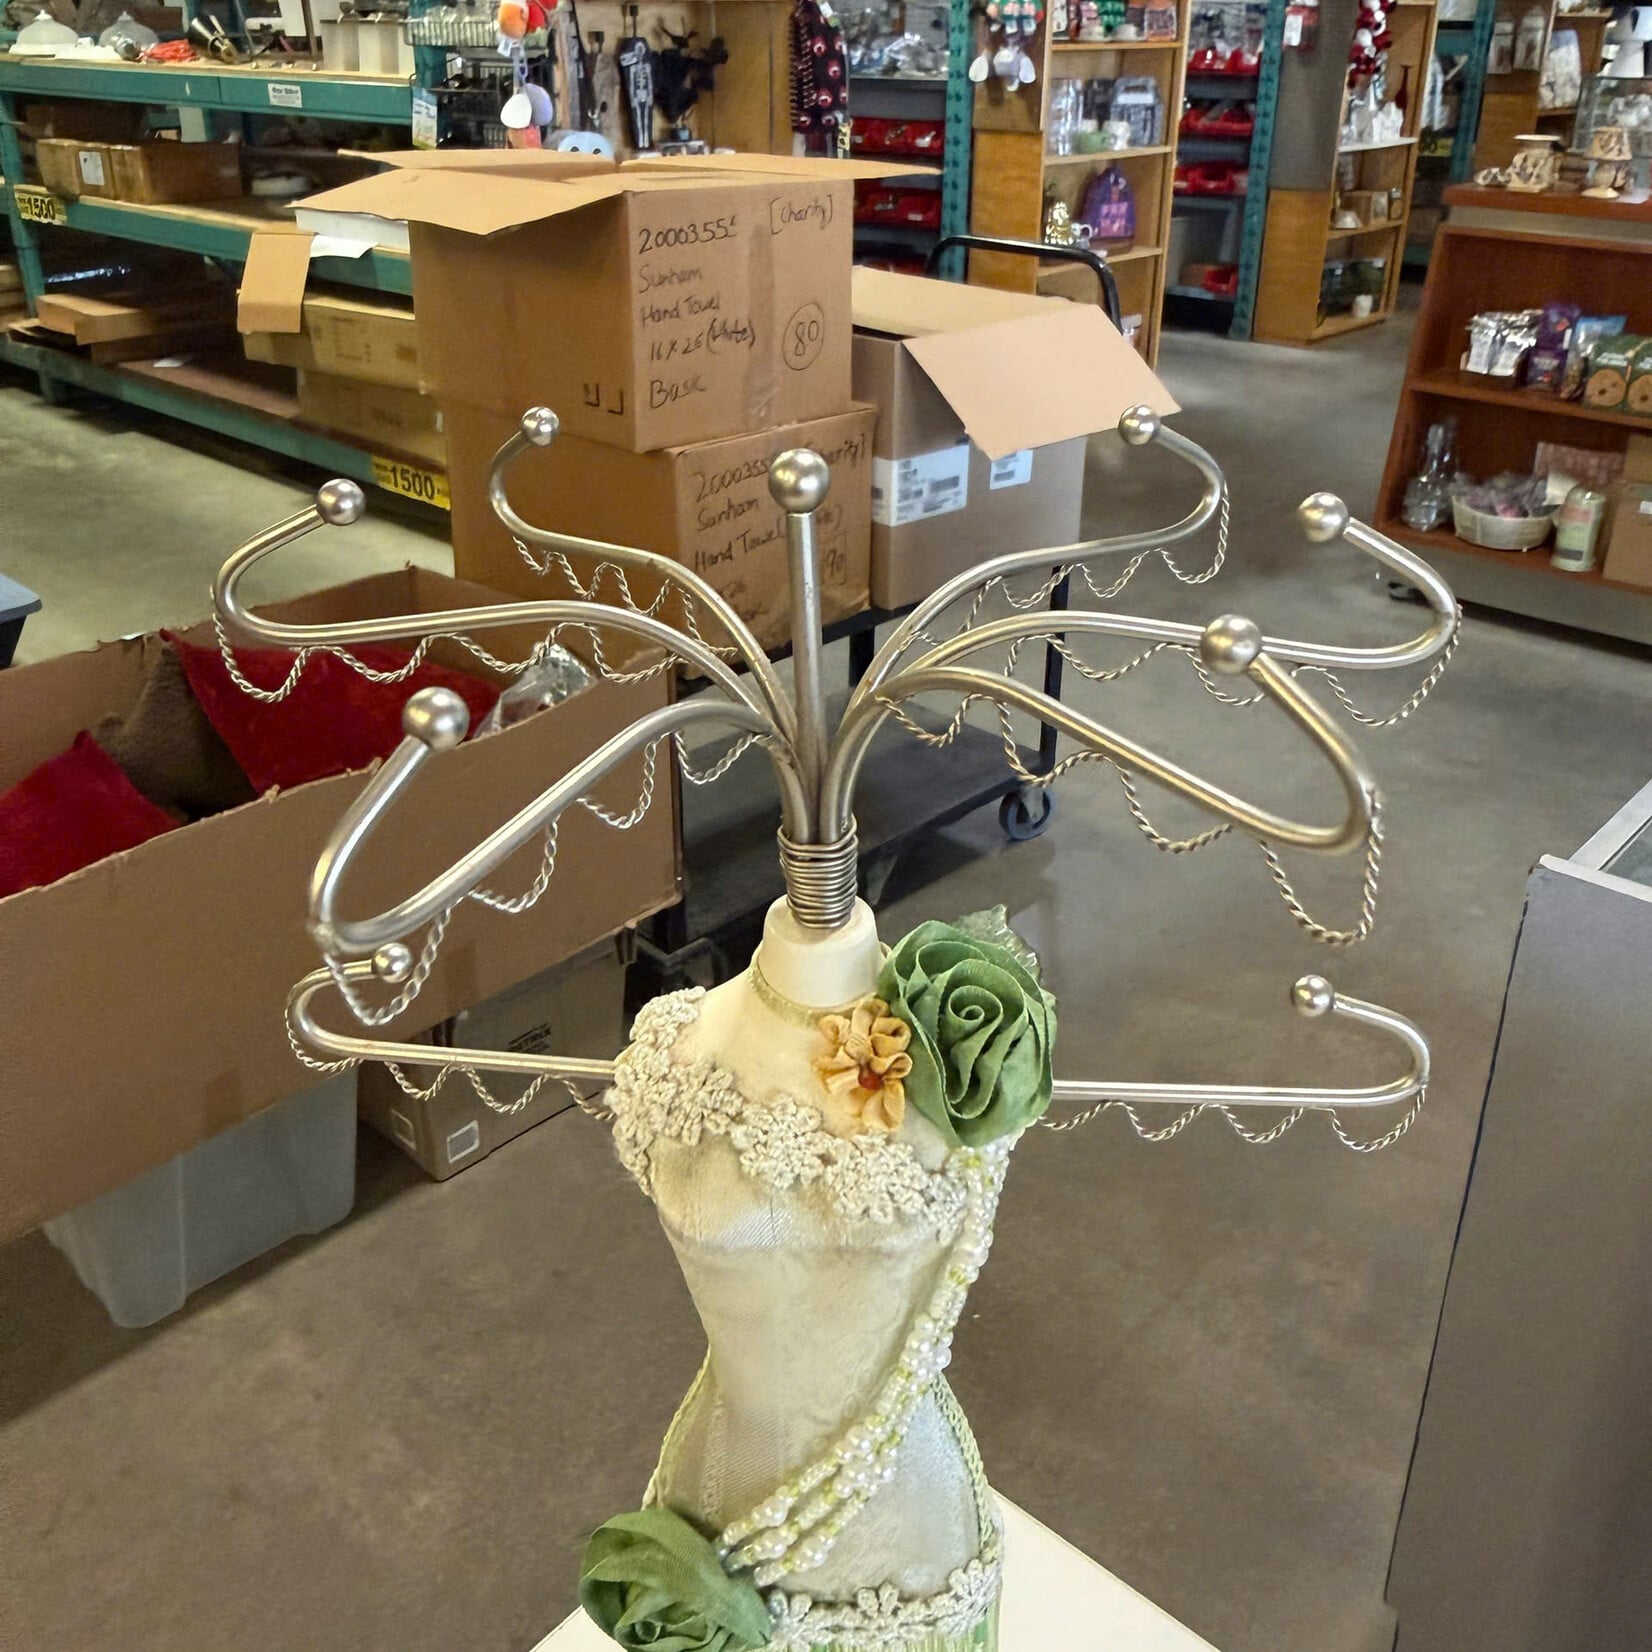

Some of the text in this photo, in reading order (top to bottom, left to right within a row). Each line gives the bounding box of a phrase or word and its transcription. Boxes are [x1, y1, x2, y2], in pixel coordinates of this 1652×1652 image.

[27, 196, 56, 220] 1500
[641, 300, 681, 328] Hand
[794, 320, 819, 357] 80
[390, 464, 436, 500] 1500
[695, 541, 732, 573] Hand
